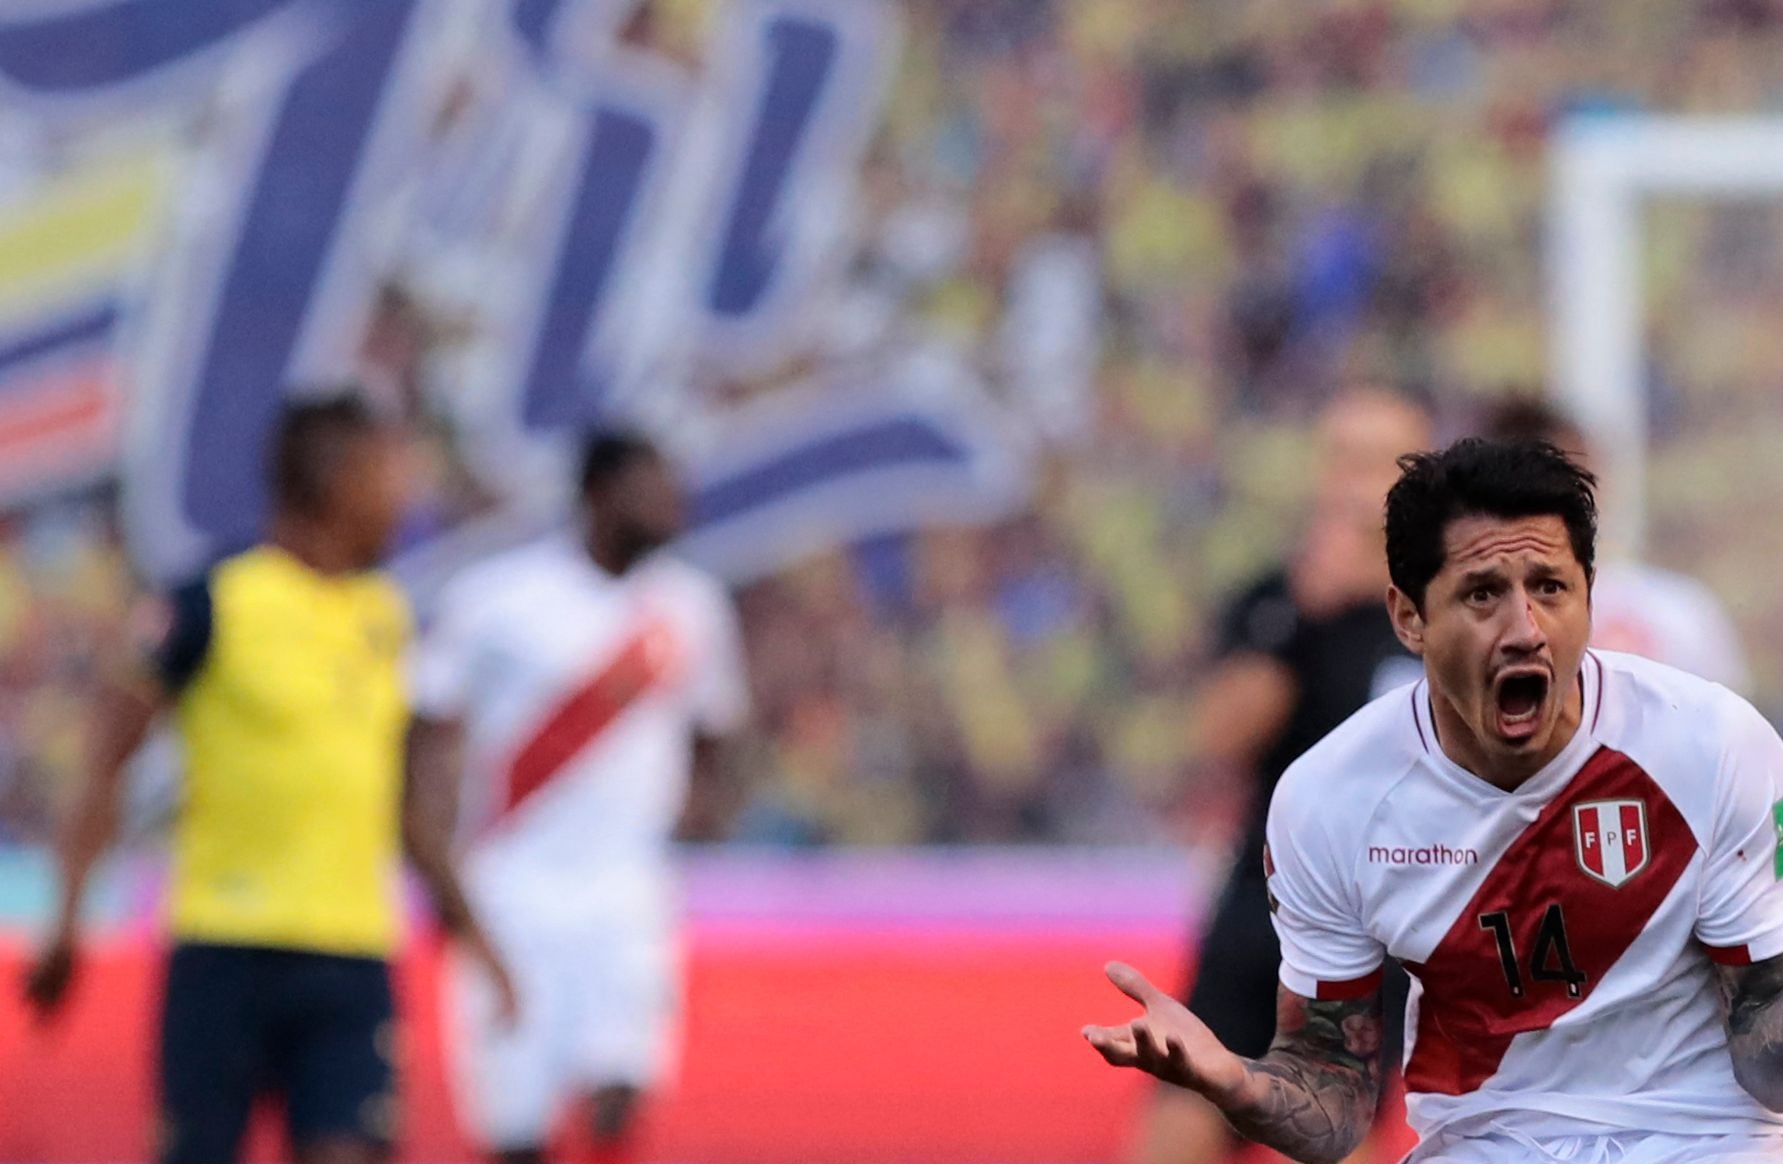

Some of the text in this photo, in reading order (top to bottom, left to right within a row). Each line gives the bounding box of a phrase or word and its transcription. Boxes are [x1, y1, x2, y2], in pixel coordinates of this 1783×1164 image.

[1584, 829, 1637, 849] FPF
[1368, 844, 1478, 864] marathon
[1478, 901, 1587, 999] 14
